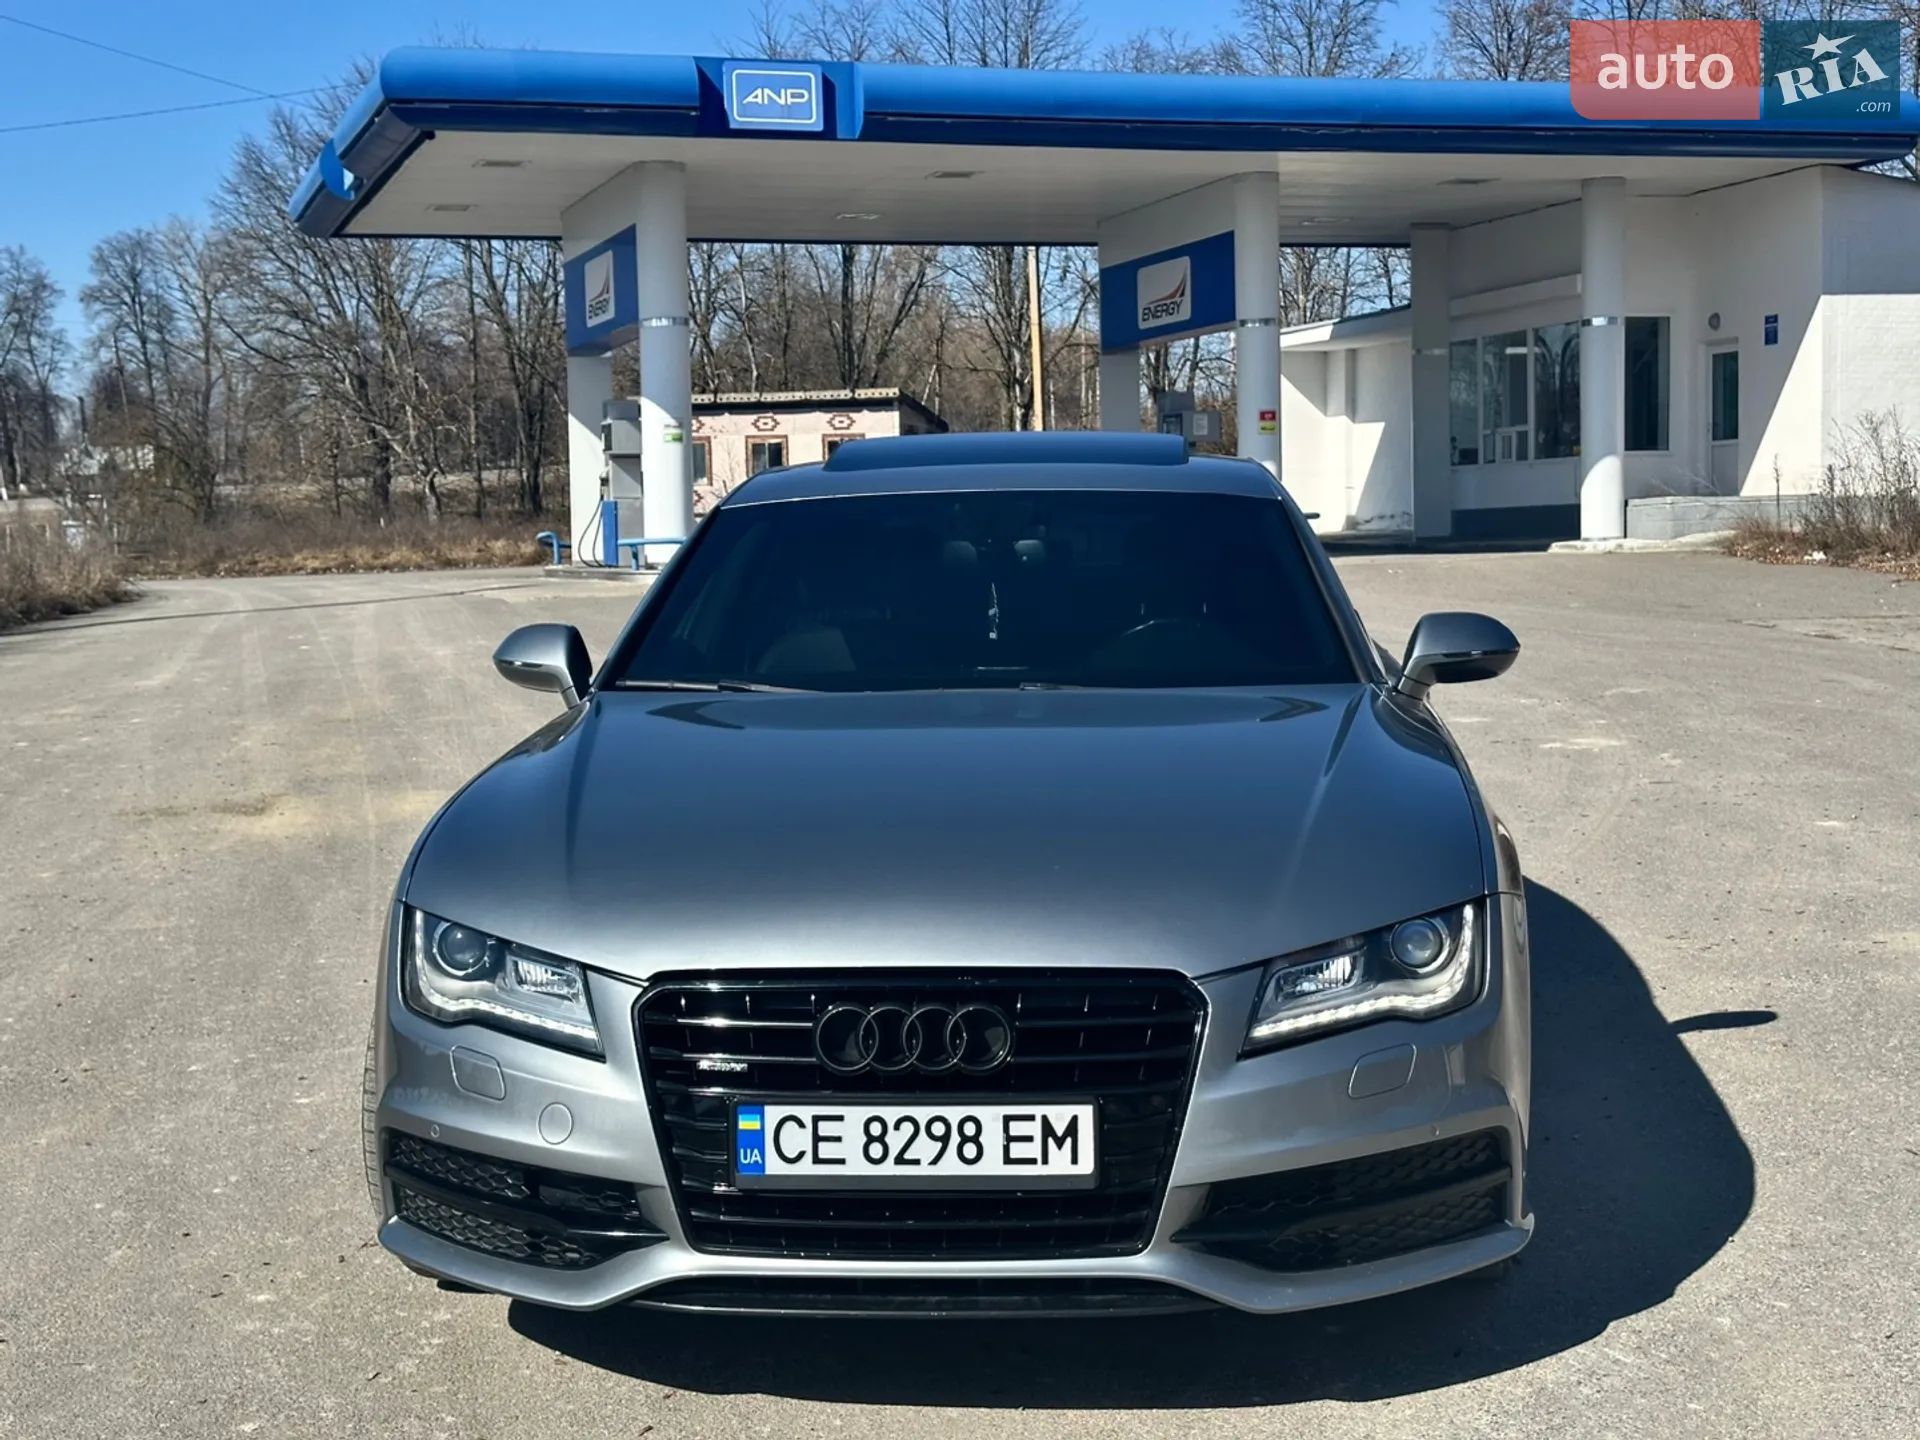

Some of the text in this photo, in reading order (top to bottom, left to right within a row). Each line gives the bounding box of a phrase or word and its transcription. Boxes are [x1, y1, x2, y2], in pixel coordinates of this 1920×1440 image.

[742, 87, 809, 105] ANP
[1142, 299, 1184, 322] ENERGY
[773, 1113, 1079, 1166] CE 8298 EM
[740, 1149, 762, 1164] UA
